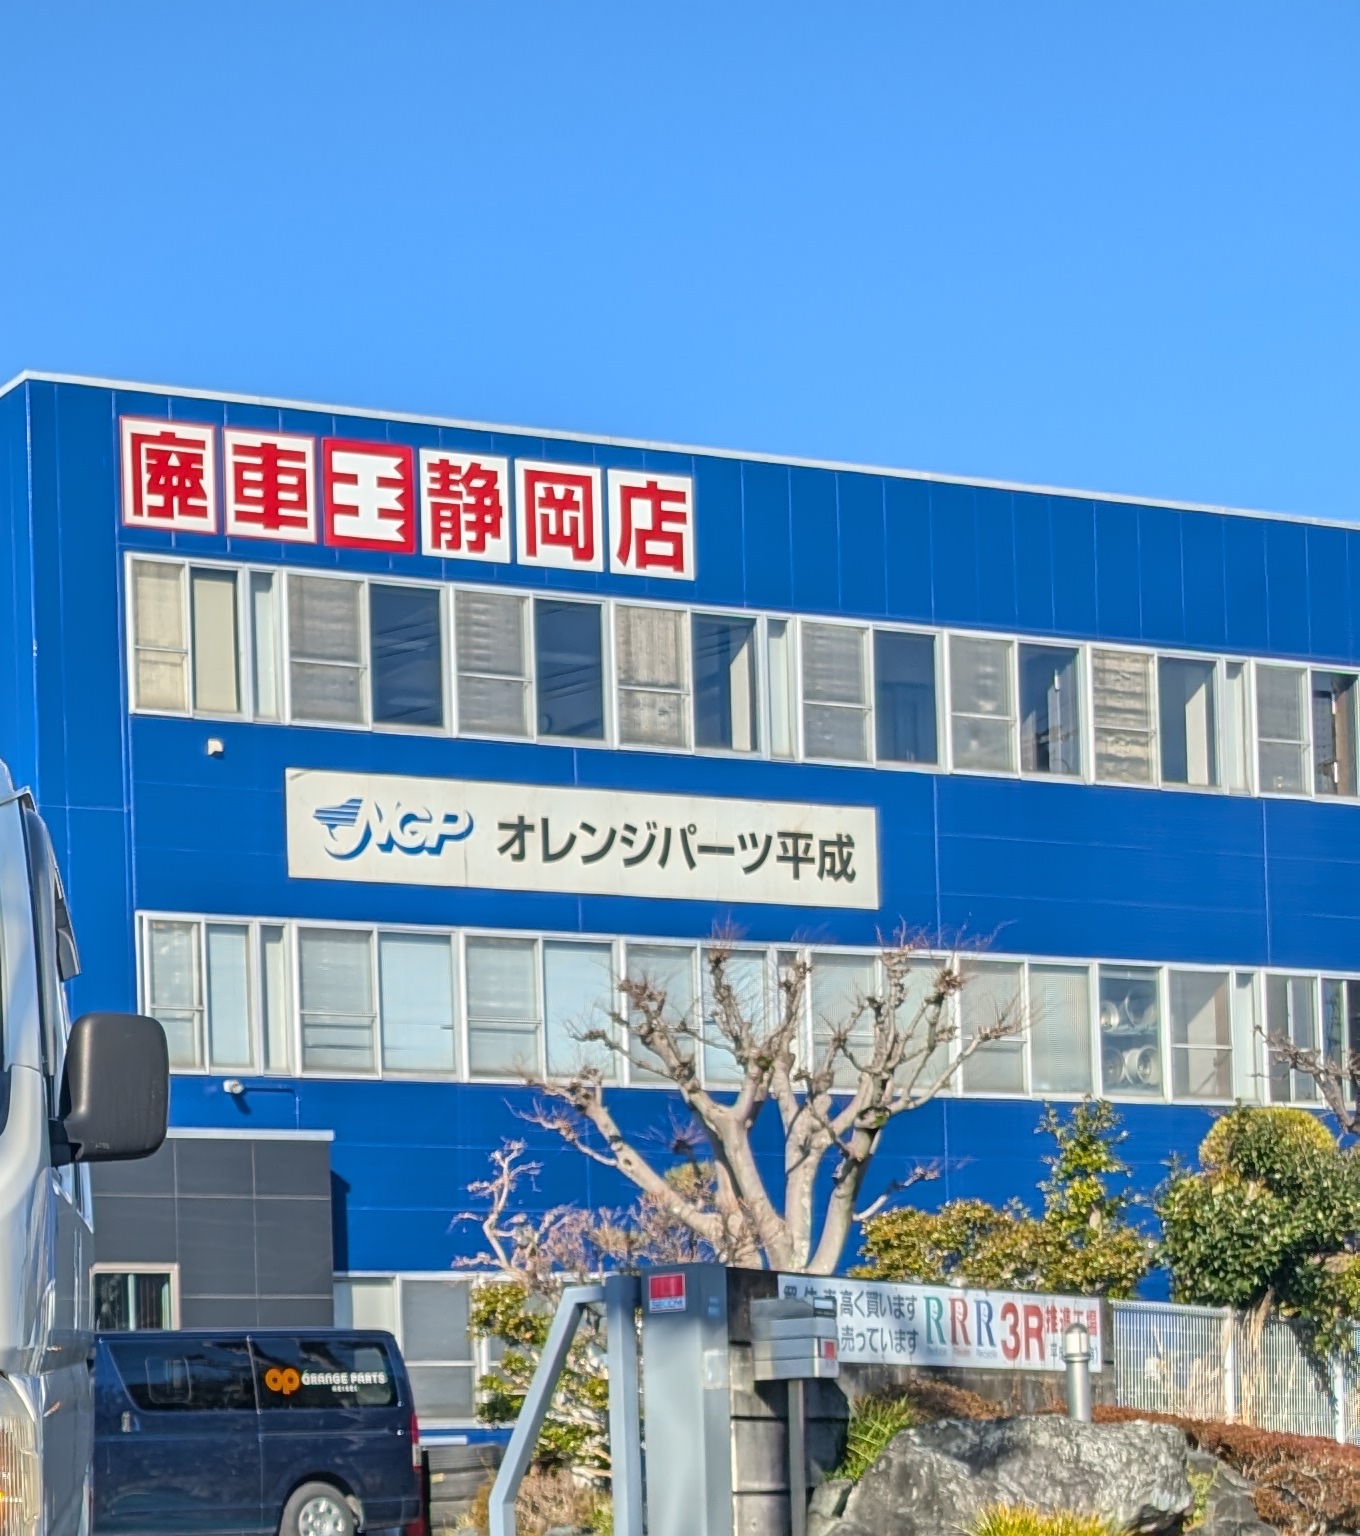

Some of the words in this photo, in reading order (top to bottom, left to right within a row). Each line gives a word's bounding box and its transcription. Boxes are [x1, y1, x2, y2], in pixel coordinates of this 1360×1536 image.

[129, 430, 688, 573] 廃車王静岡店
[497, 813, 857, 882] オレンジパーツ平成
[350, 1371, 387, 1385] PARTS
